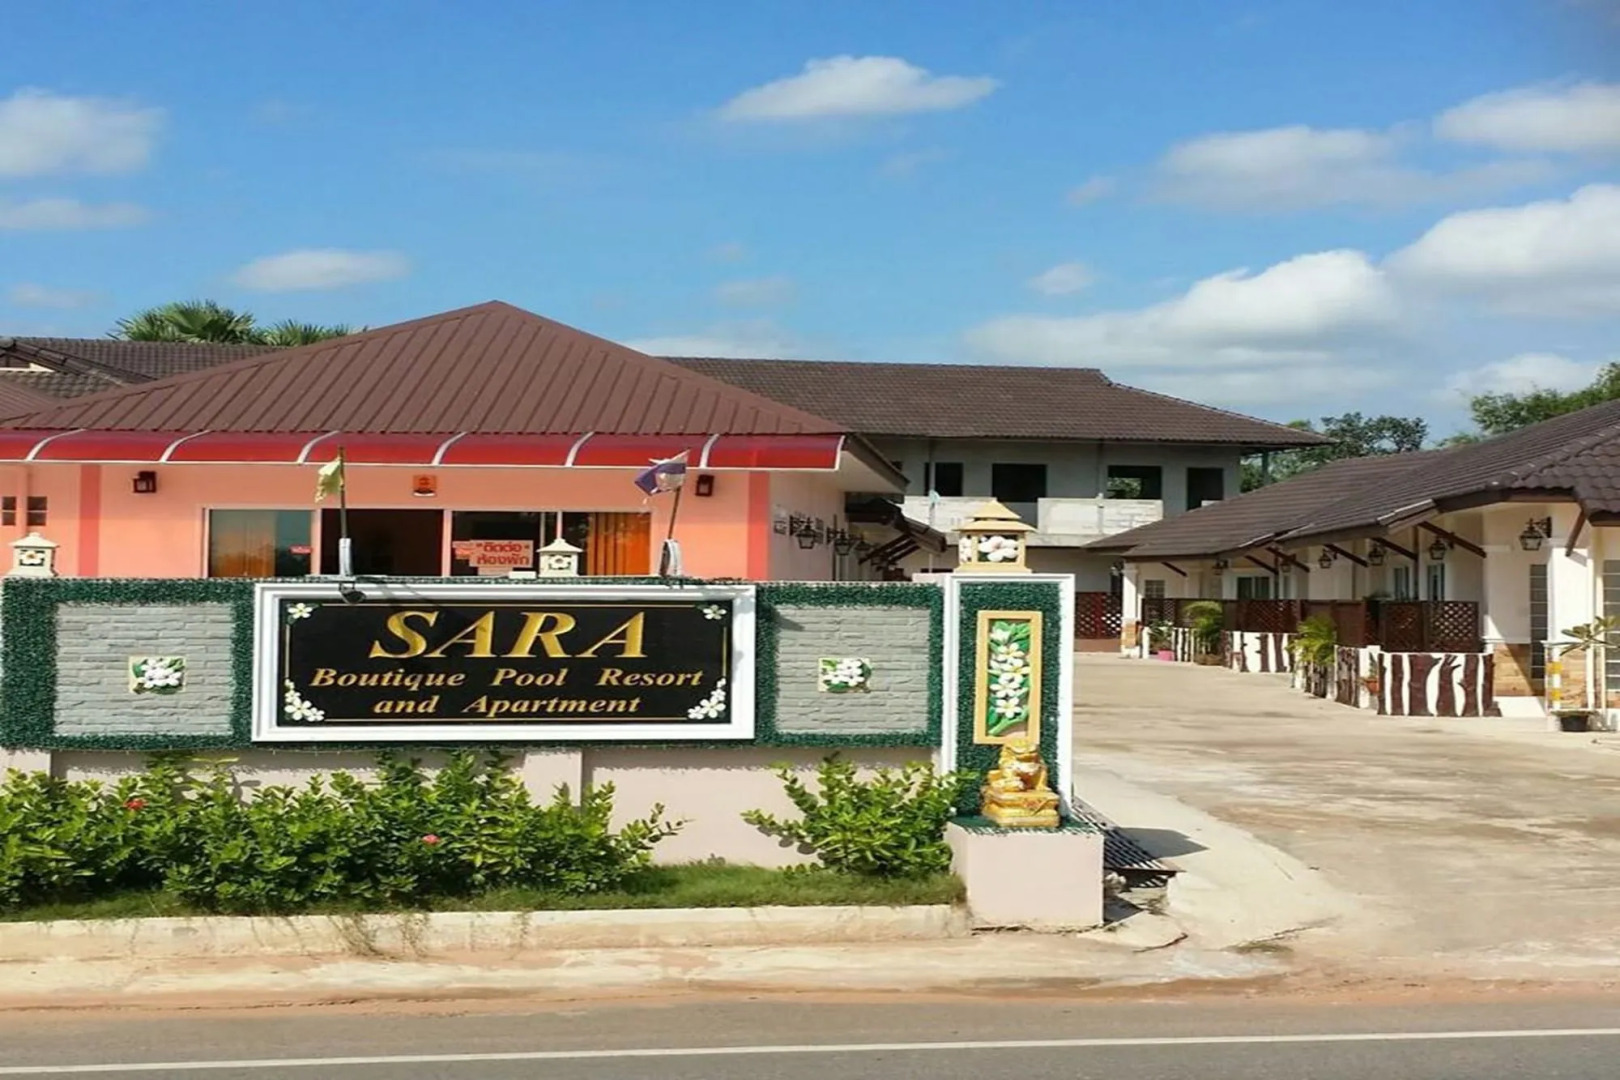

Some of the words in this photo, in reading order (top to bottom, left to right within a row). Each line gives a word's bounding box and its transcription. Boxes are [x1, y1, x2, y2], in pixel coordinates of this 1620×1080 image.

[368, 611, 648, 659] SARA
[308, 668, 466, 691] Boutique
[490, 668, 569, 686] Pool
[595, 668, 704, 686] Resort
[373, 695, 440, 713] and
[460, 695, 641, 718] Apartment
